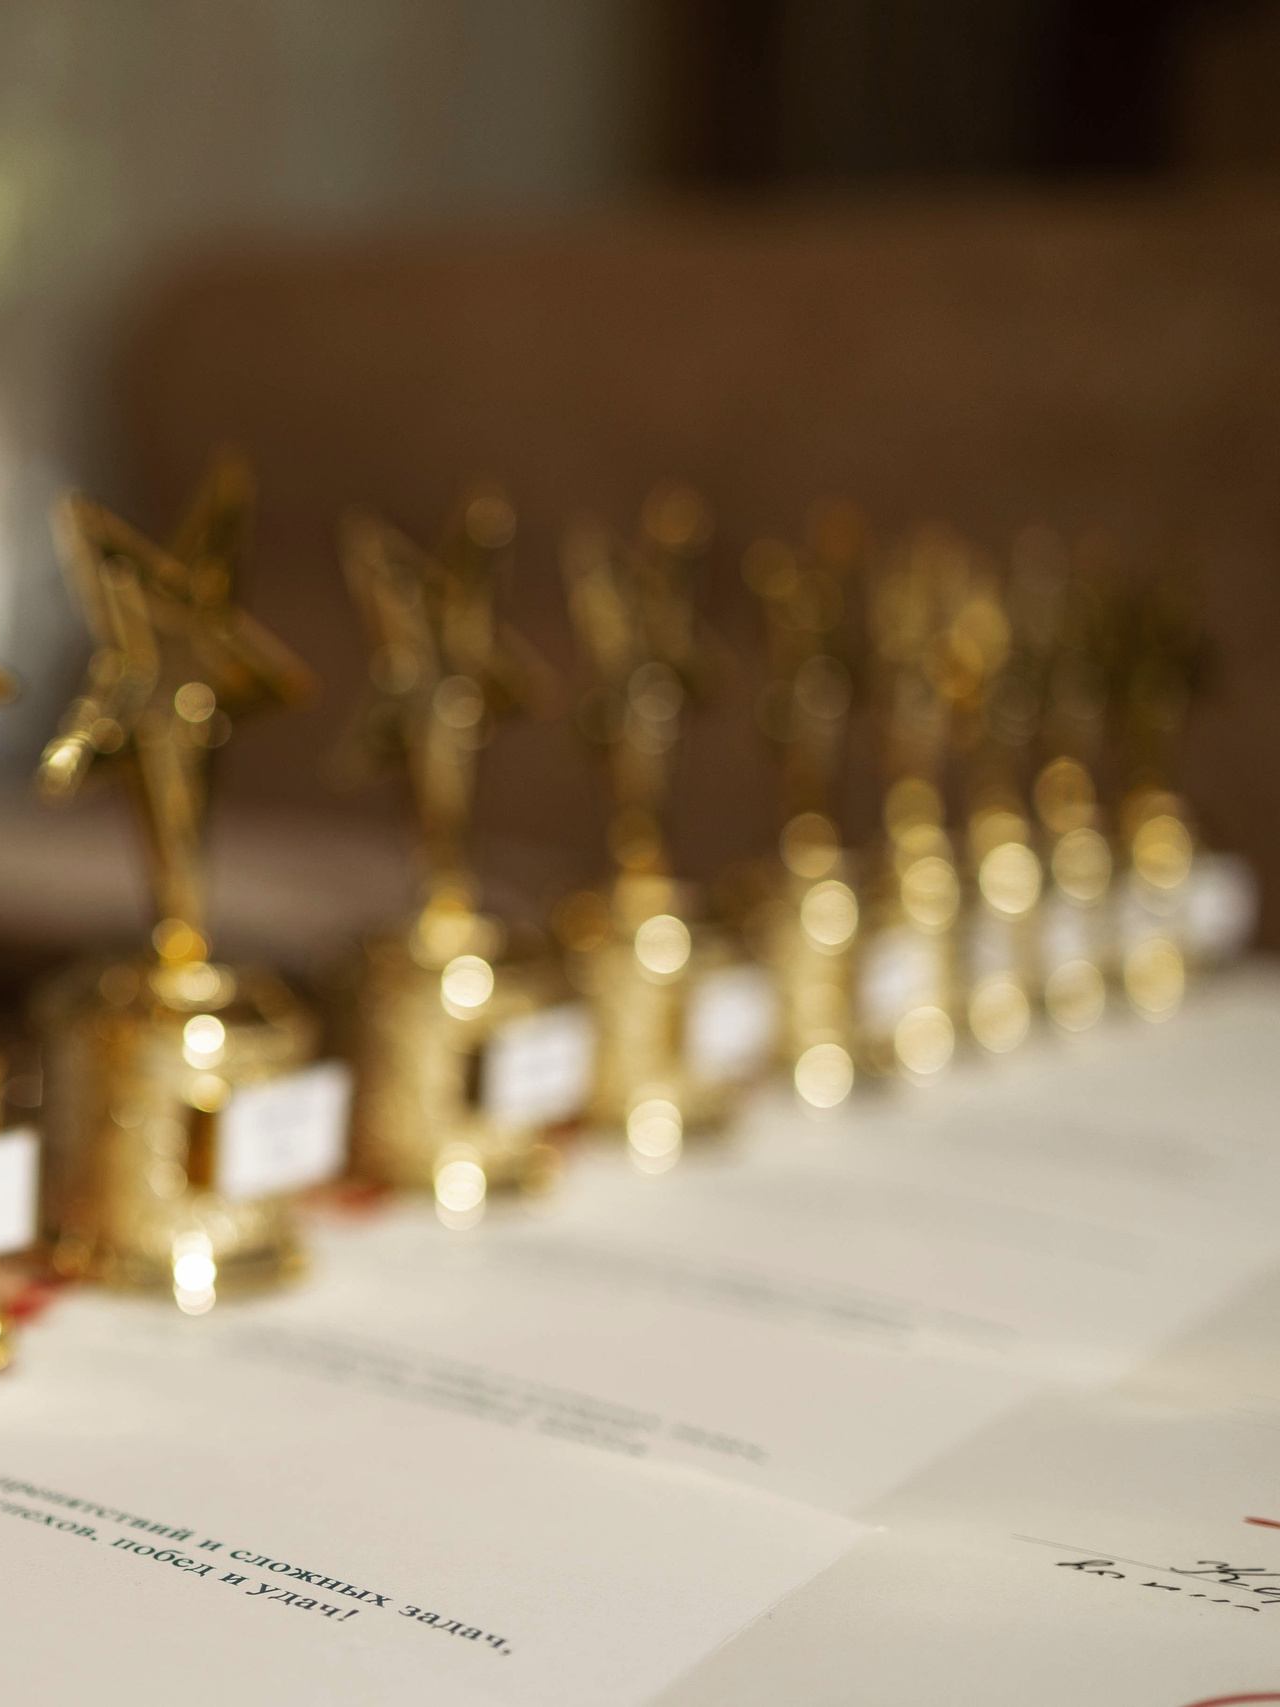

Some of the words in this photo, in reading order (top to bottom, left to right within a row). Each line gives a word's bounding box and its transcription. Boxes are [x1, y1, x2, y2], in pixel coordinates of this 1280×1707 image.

[109, 1537, 217, 1578] побед
[217, 1572, 250, 1586] и
[245, 1582, 360, 1622] удач!
[195, 1539, 223, 1553] и
[229, 1549, 394, 1608] сложных
[398, 1604, 513, 1657] задач,
